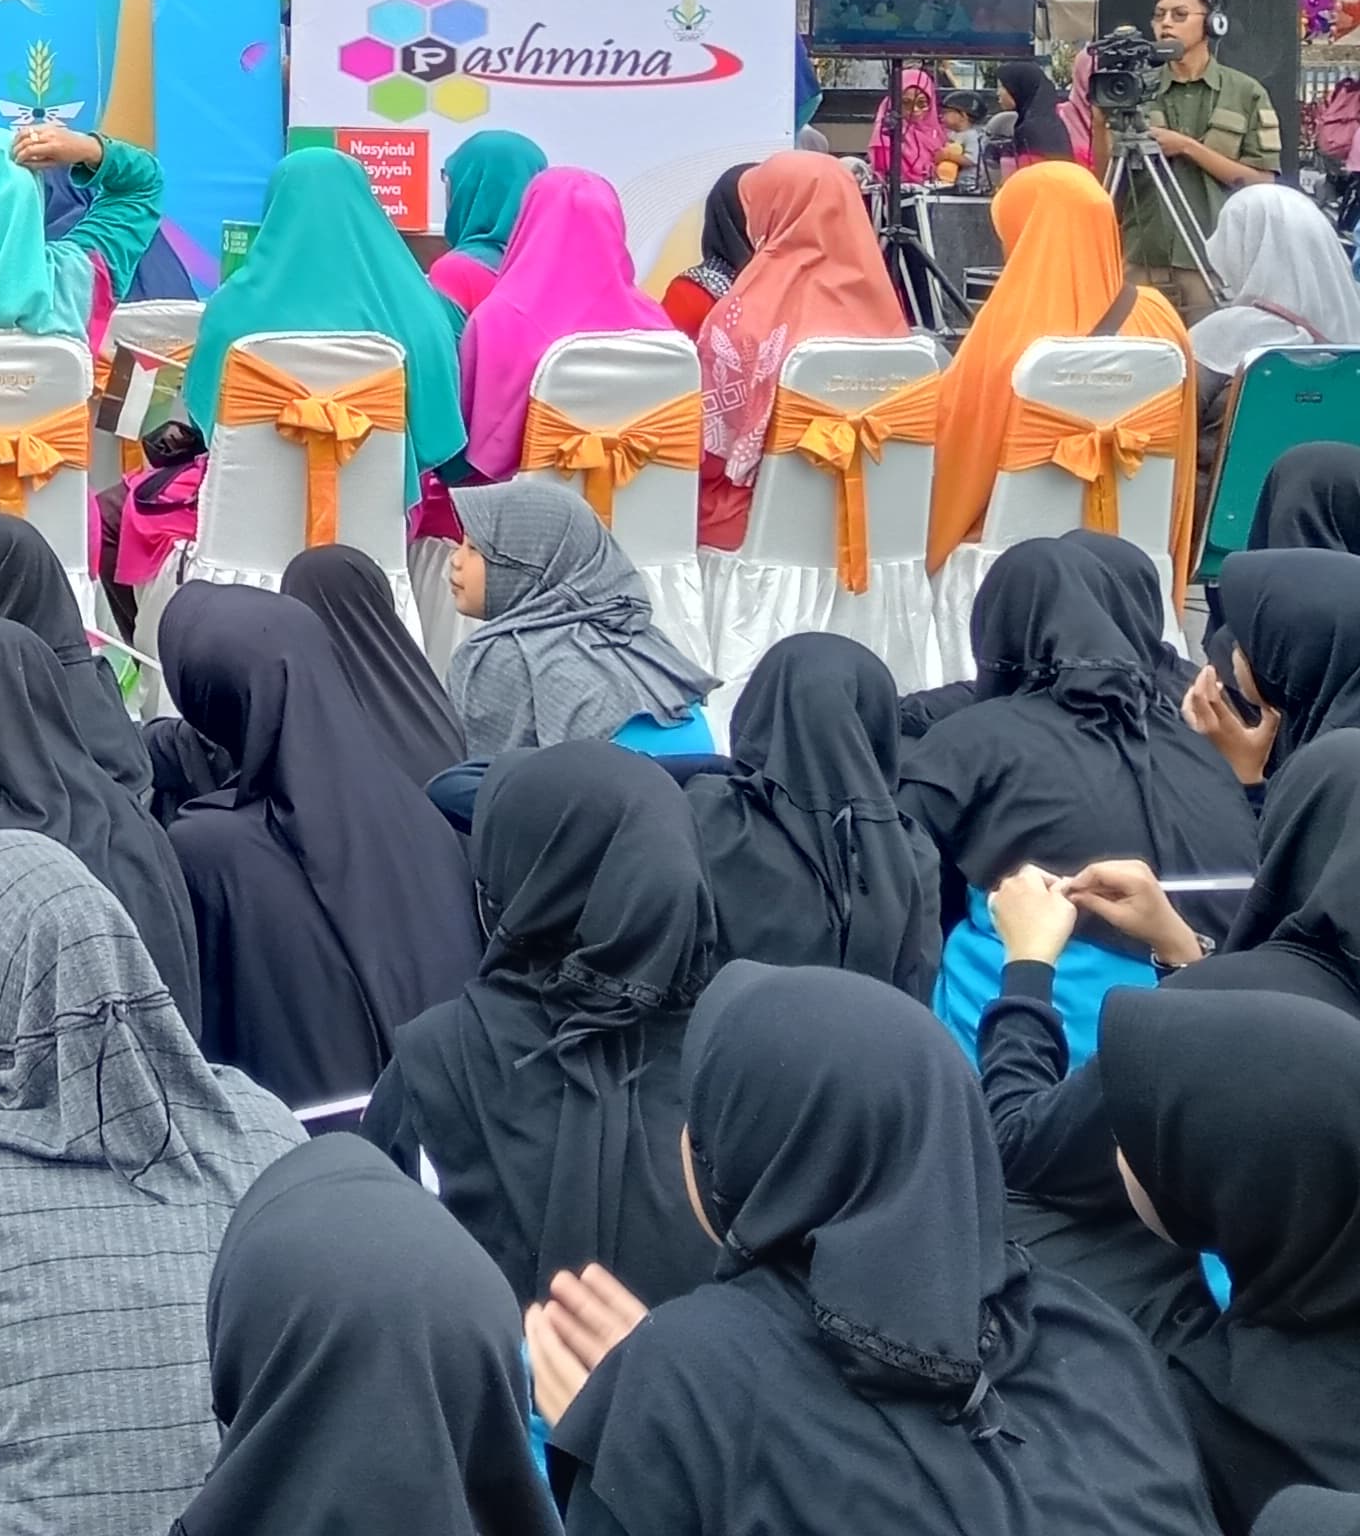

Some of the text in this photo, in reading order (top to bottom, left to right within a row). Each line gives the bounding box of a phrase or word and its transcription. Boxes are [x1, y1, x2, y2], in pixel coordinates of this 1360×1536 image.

[410, 21, 673, 77] Pashmina
[350, 139, 415, 159] Nasyiatul
[363, 160, 412, 179] isyiyah
[370, 185, 401, 195] awa
